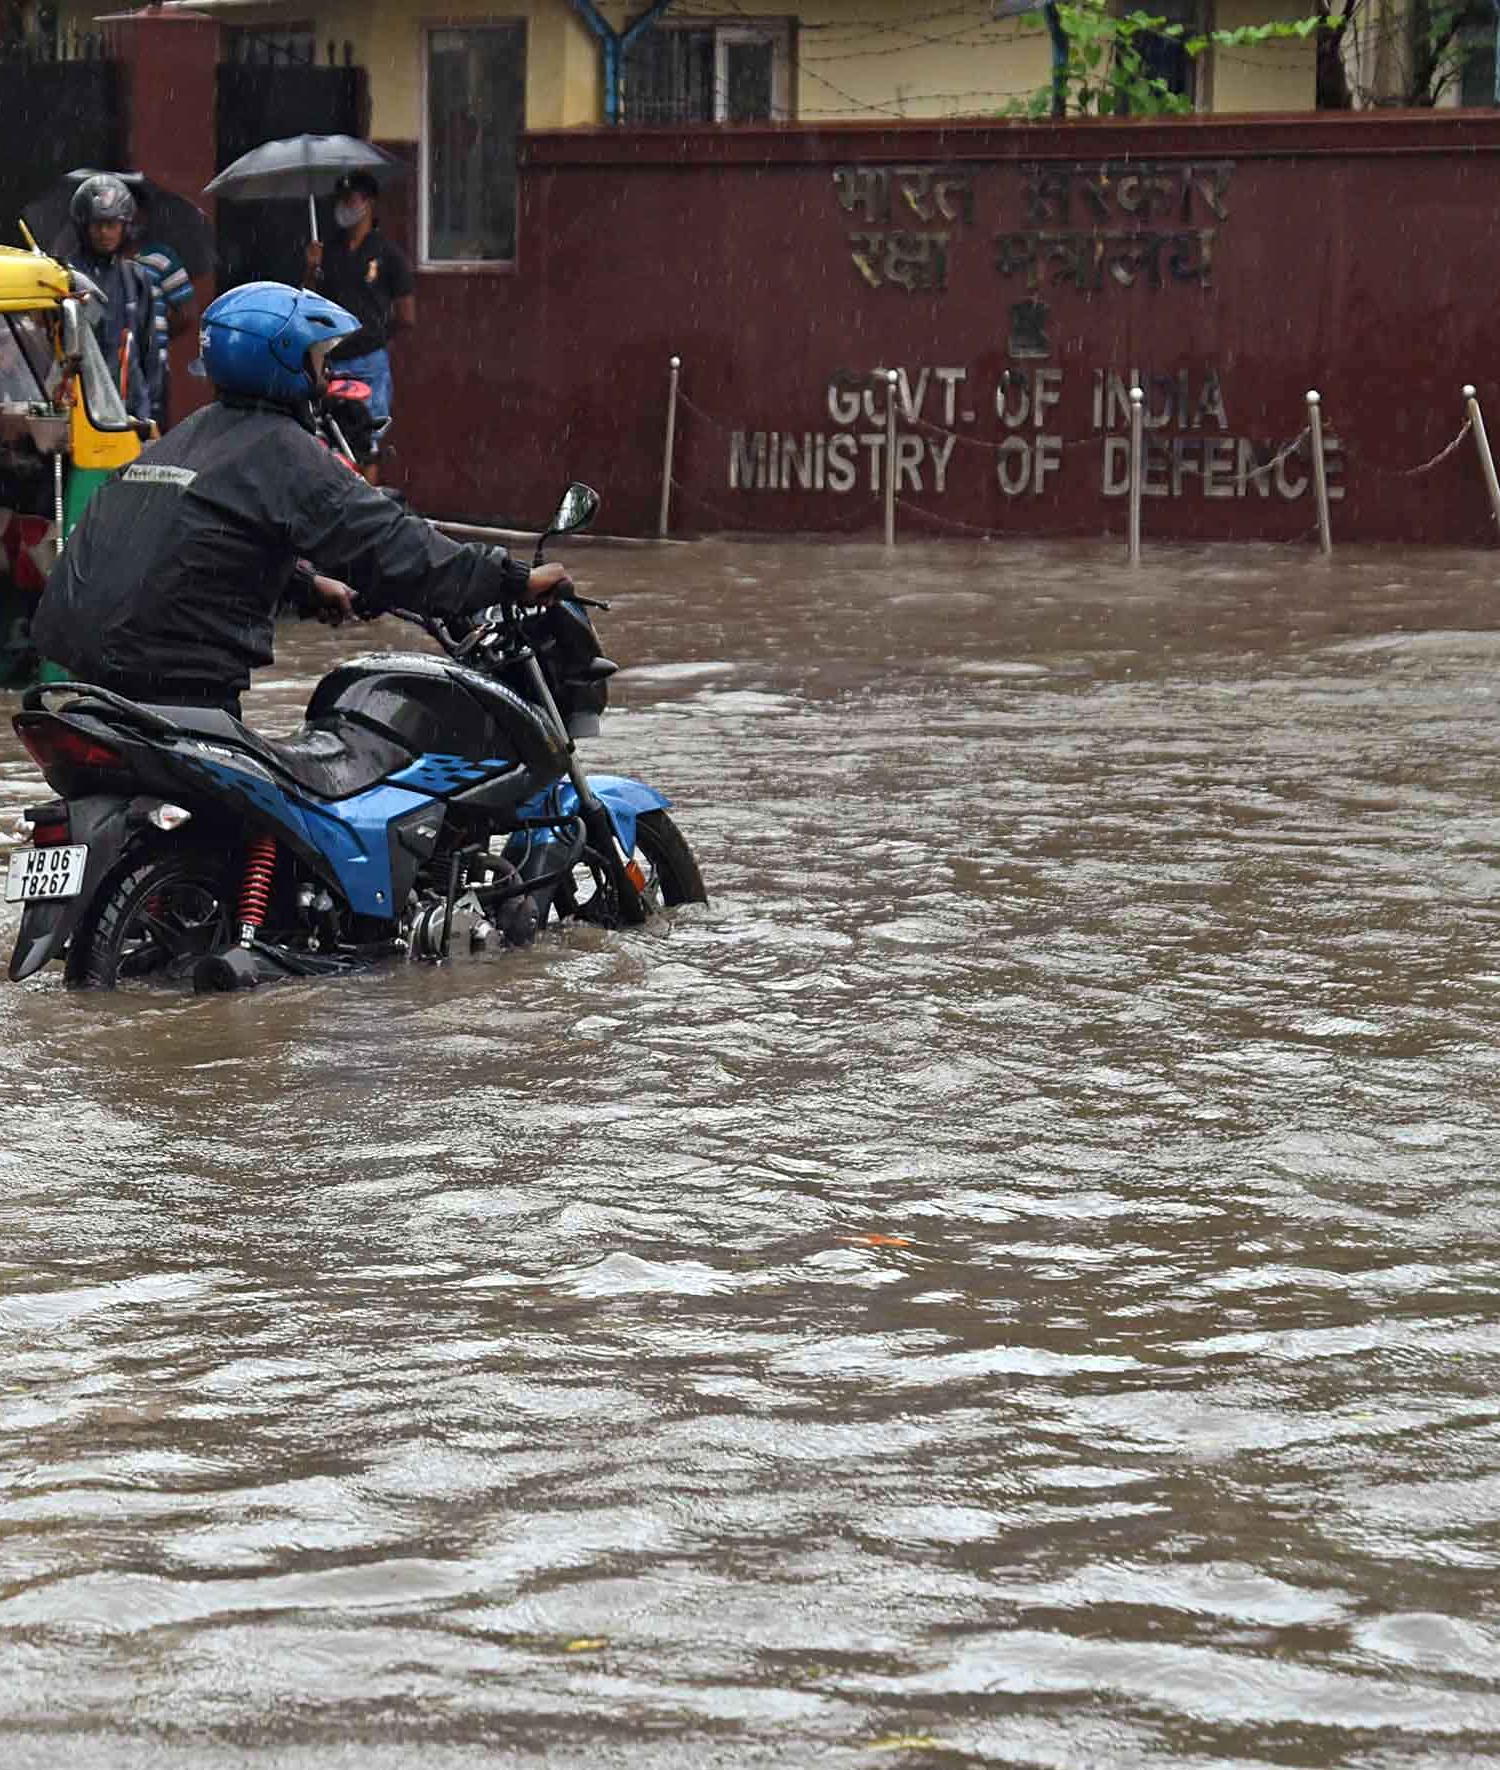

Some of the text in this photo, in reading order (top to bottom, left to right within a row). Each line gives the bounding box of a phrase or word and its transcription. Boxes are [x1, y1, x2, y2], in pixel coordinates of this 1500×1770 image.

[828, 367, 1228, 429] GOVT. OF INDIA
[729, 431, 1345, 498] MINISTRY OF DEFENCE
[26, 850, 71, 874] WB 06
[21, 872, 70, 897] T8267
